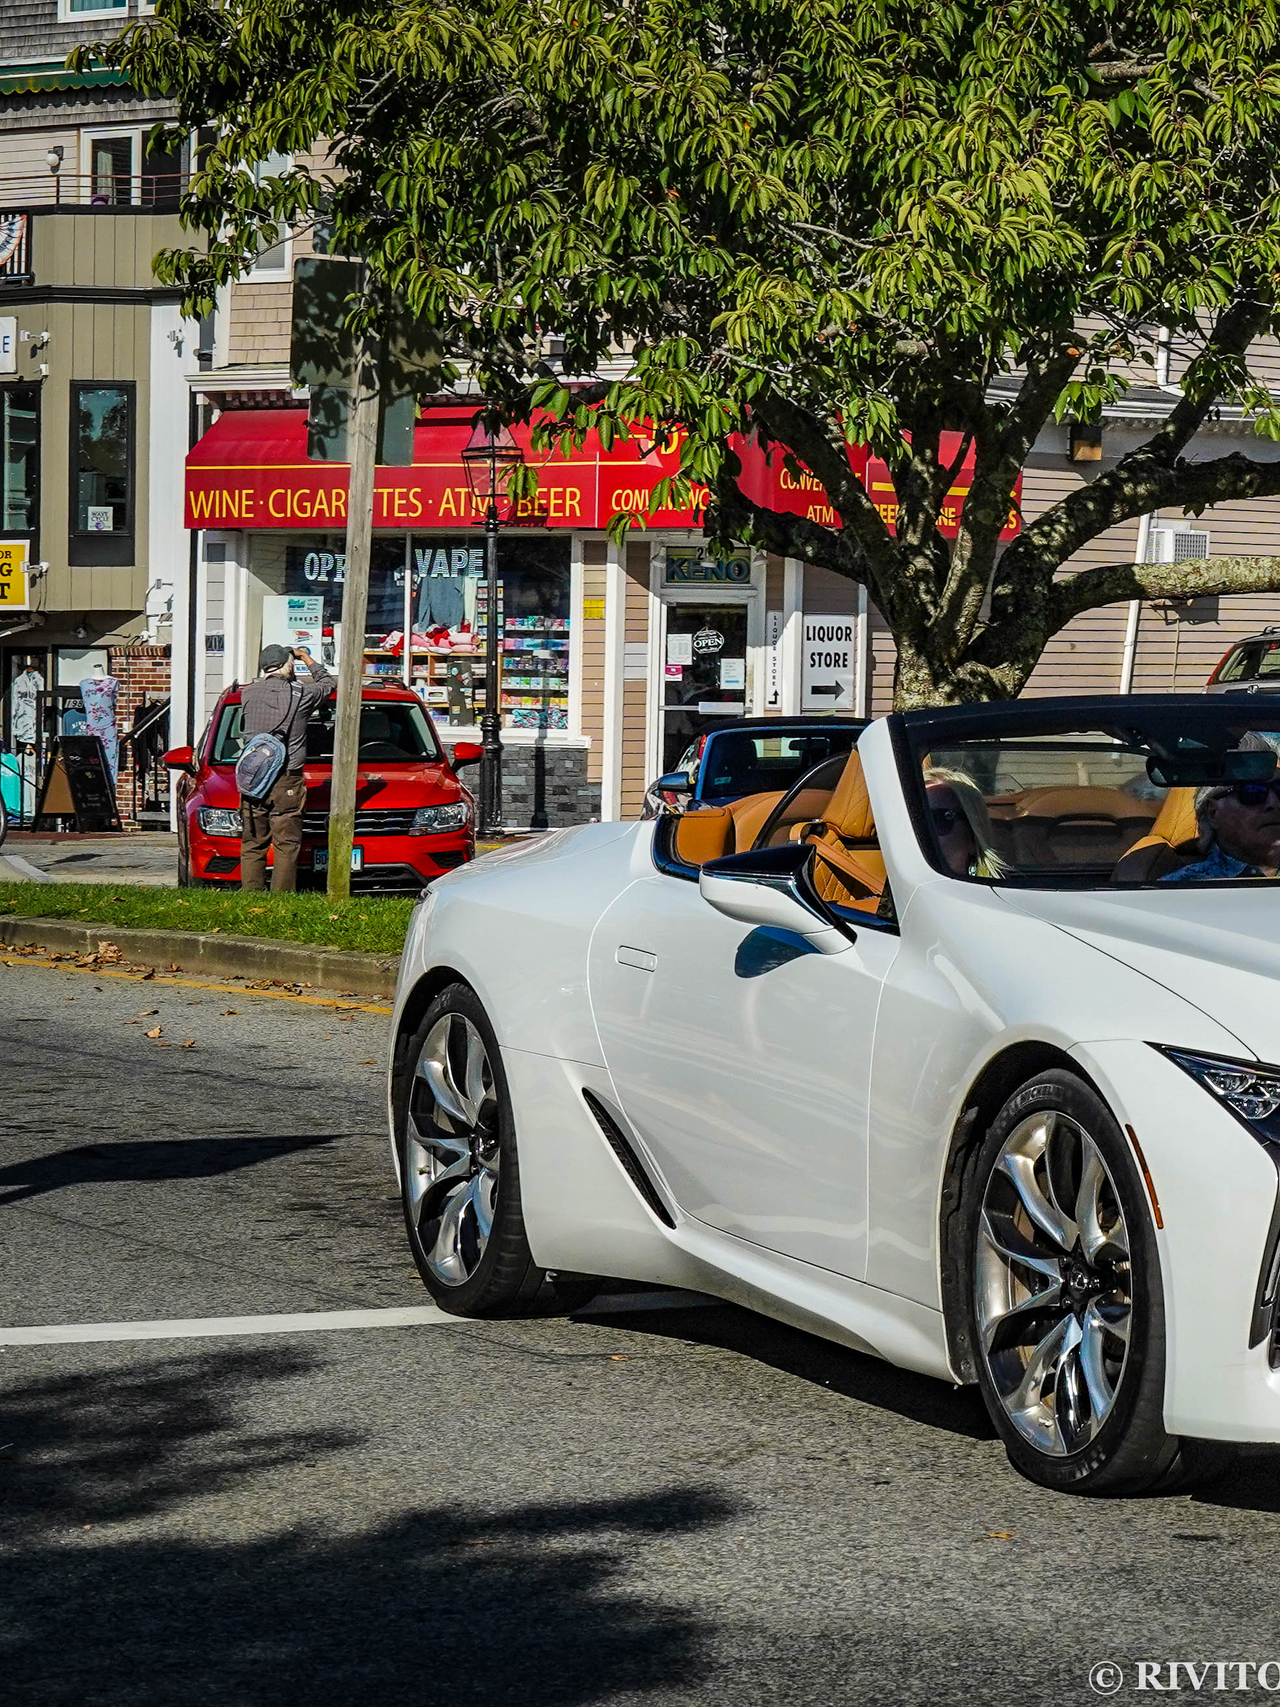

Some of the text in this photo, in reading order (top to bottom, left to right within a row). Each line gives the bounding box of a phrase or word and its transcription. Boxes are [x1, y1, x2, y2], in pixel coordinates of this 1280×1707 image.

[189, 487, 581, 518] WINE CIGARTES ATM BEER
[807, 505, 834, 523] ATM
[415, 549, 484, 578] VAPE
[667, 557, 750, 581] KENO
[694, 638, 723, 648] OPEN
[806, 625, 852, 643] LIQUOR
[810, 652, 848, 668] STORE
